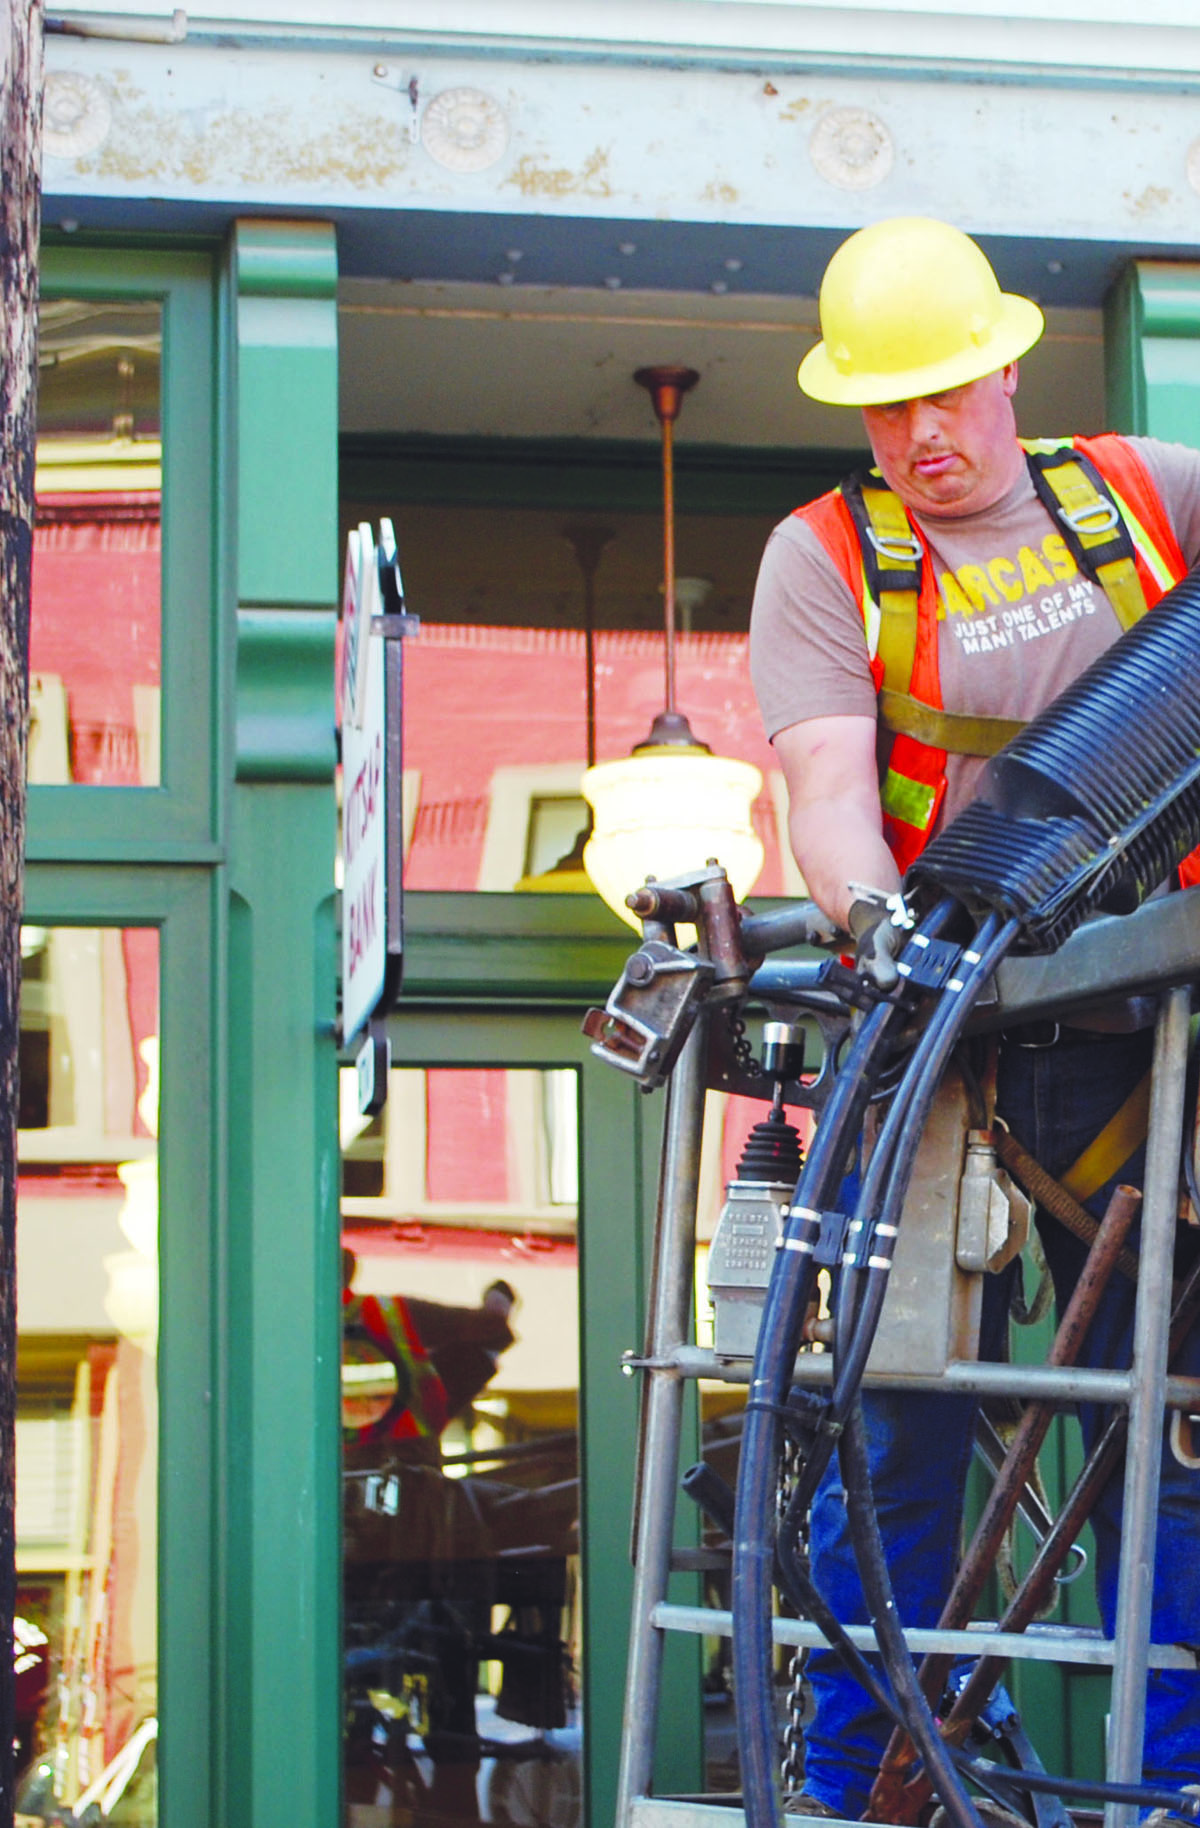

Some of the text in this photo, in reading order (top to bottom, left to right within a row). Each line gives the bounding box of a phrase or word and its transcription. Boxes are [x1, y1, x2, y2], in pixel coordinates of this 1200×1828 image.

[936, 534, 1078, 621] ARCAS
[954, 580, 1095, 639] JUST ONE OF MY
[961, 598, 1096, 655] MANY TALENTS
